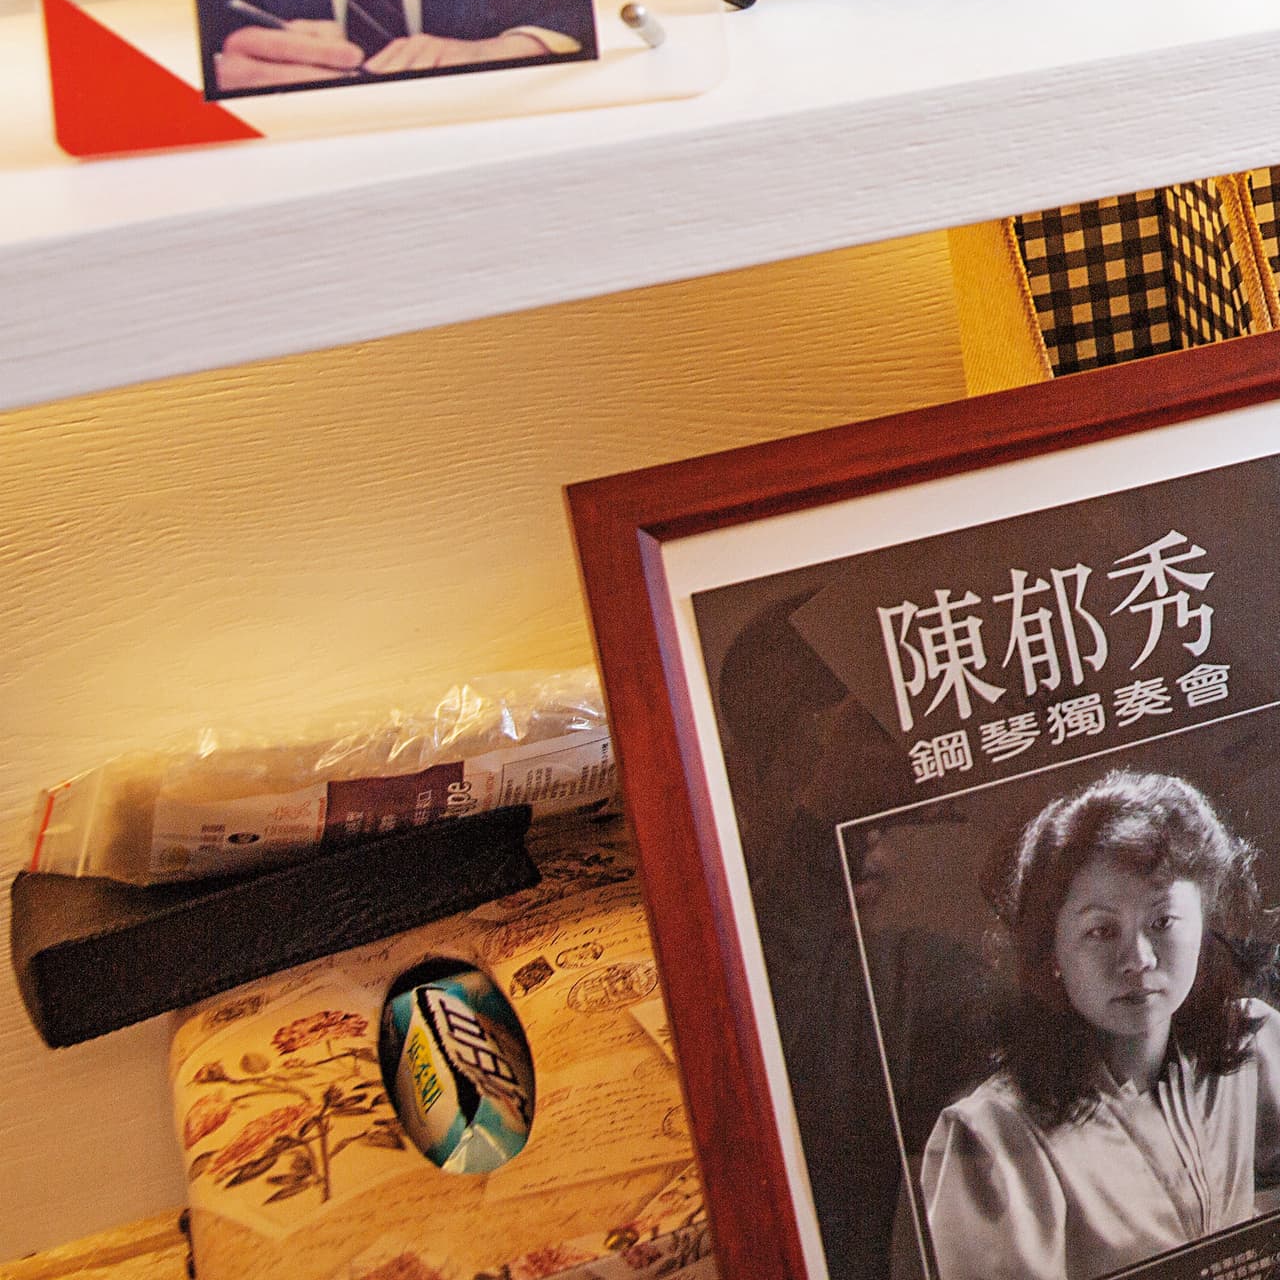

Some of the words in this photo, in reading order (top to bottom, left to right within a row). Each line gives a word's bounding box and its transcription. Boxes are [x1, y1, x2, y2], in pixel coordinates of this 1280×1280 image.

[877, 529, 1214, 732] 陳郁秀
[908, 663, 1231, 784] 鋼琴獨奏會
